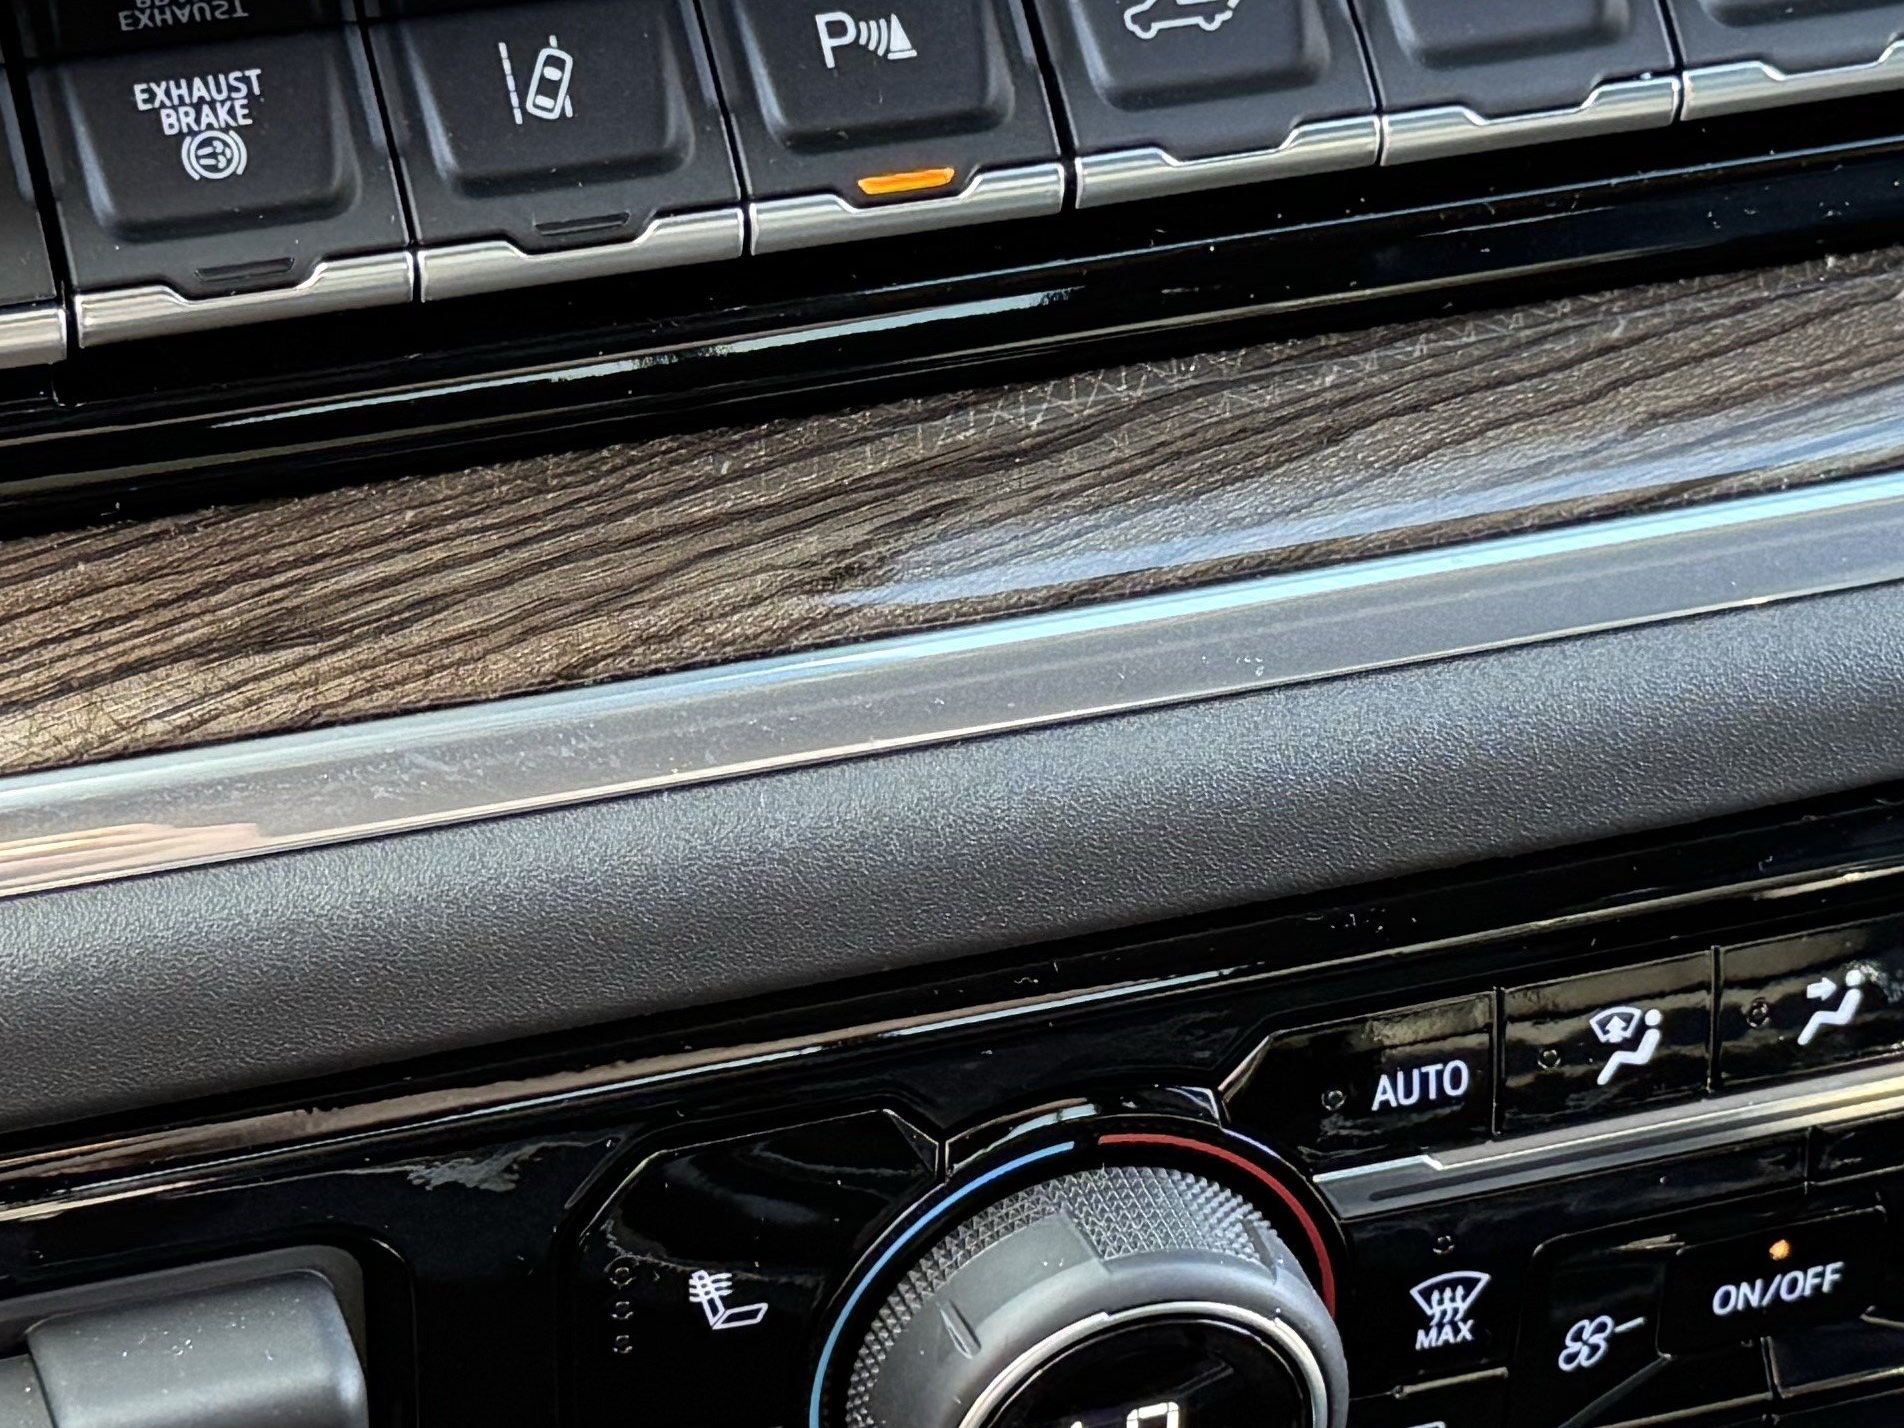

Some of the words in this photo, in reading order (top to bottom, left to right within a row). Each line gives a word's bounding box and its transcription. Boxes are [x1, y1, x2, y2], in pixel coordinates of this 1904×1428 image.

[133, 68, 262, 111] EXHAUST
[160, 99, 253, 134] BRAKE
[1372, 1060, 1469, 1110] AUTO
[1713, 1262, 1843, 1315] ON/OFF
[1416, 1317, 1473, 1349] MAX
